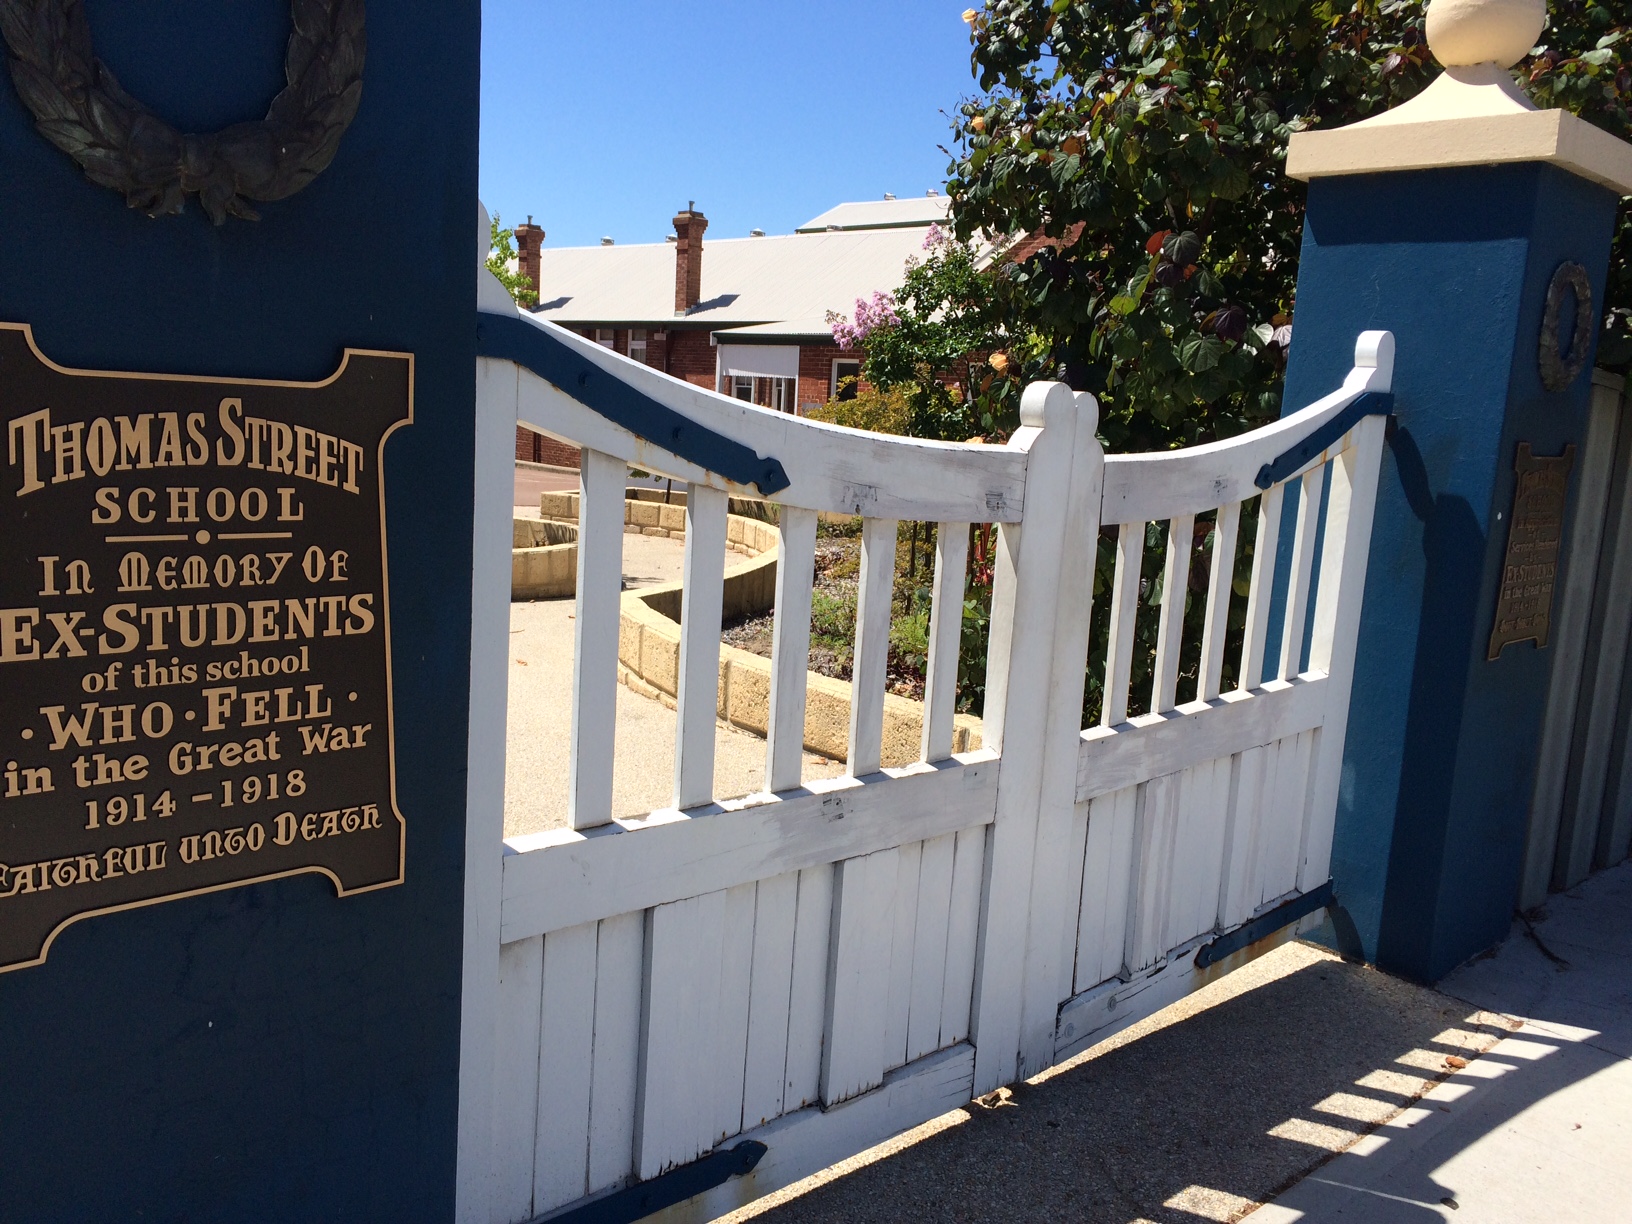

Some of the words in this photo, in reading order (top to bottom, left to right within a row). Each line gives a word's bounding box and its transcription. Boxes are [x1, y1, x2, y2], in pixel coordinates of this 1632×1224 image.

[9, 408, 209, 497] THOMAS
[217, 398, 363, 494] STREET
[92, 487, 303, 523] SCHOOL
[118, 552, 293, 592] MEMORY
[1505, 563, 1554, 583] EX-STUDENTS
[0, 593, 374, 662] EX-STUDENTS
[82, 662, 122, 693] of
[132, 657, 197, 688] this
[206, 646, 310, 681] school
[40, 702, 173, 750] WHO
[202, 684, 331, 731] FELL
[4, 761, 55, 797] in
[72, 754, 149, 787] the
[169, 731, 281, 775] Great
[298, 724, 371, 755] War
[179, 823, 265, 863] UNTO
[273, 804, 382, 845] DEATH
